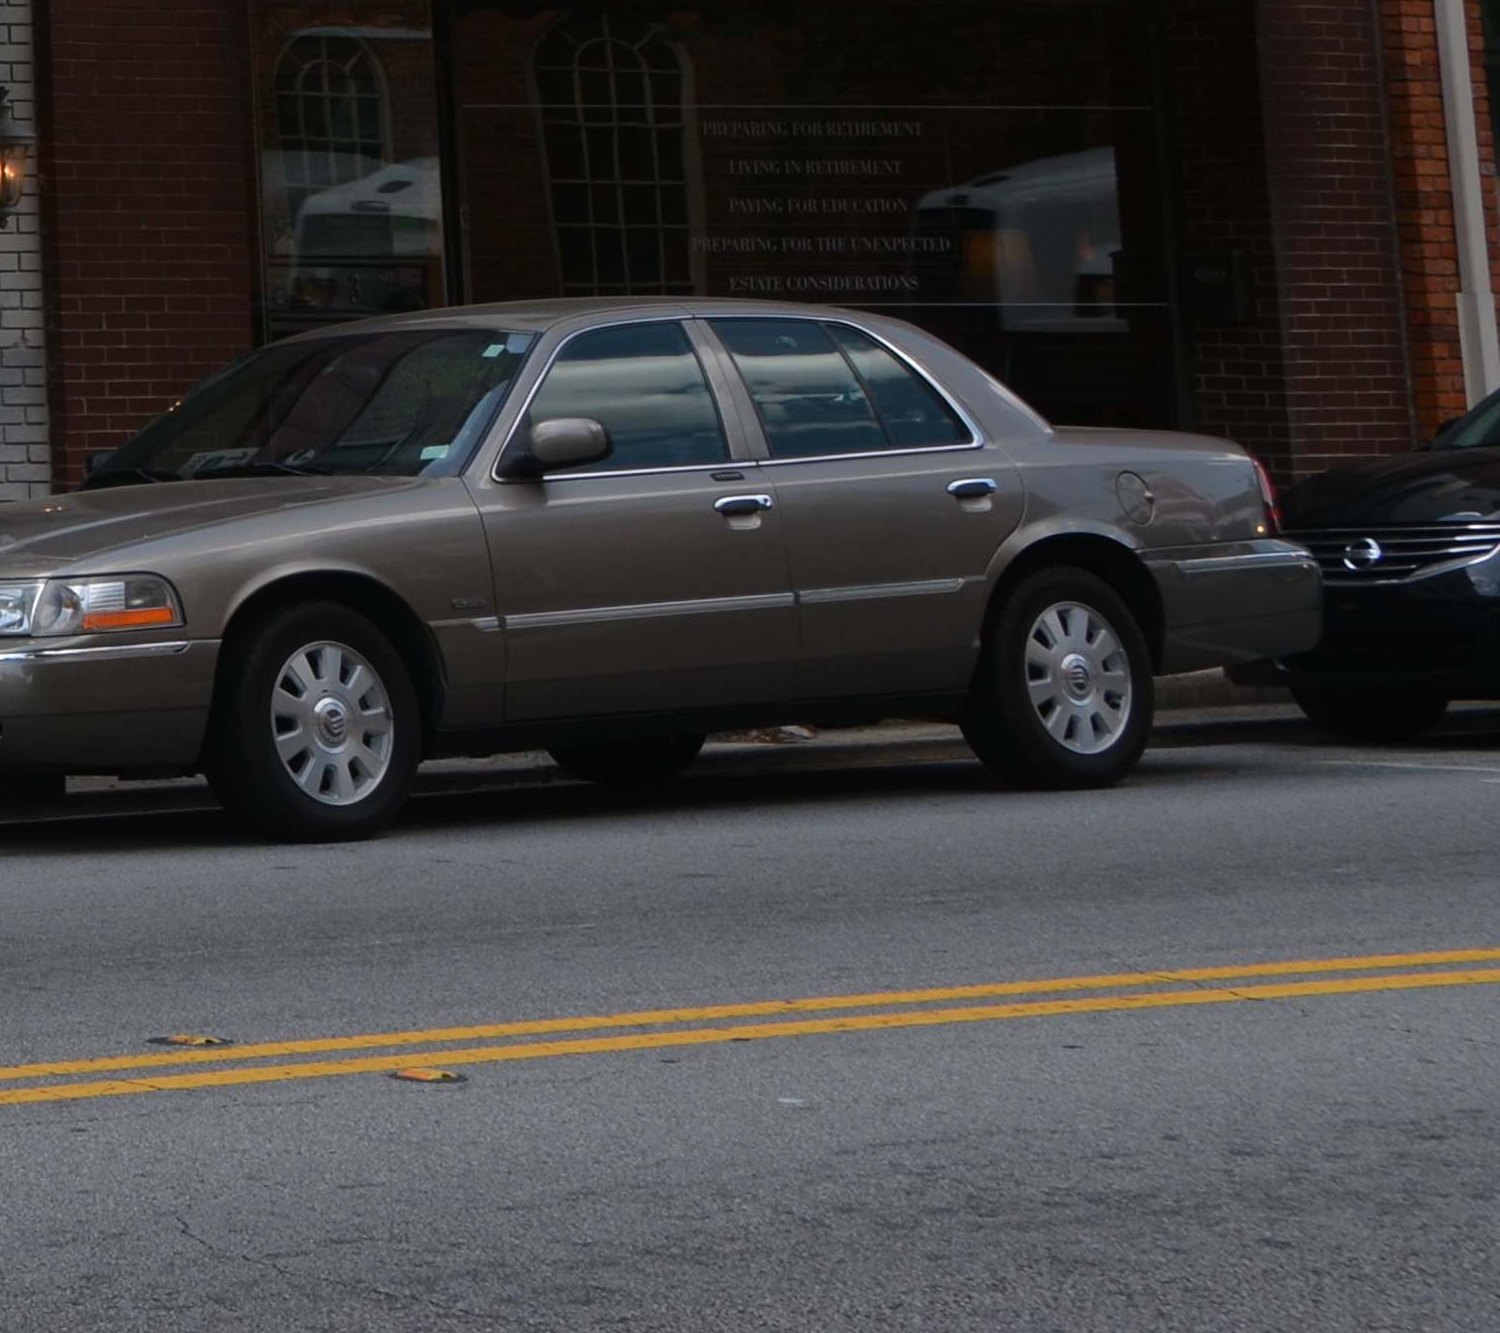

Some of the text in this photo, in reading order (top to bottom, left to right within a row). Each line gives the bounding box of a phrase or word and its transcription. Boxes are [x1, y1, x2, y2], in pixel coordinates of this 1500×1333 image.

[702, 121, 924, 137] PREPARING FOR RETIREMENT
[729, 160, 904, 175] LIVING IN RETIREMENT
[729, 198, 908, 214] PAYING FOR EDUCATION
[692, 237, 950, 252] PREPARING FOR THE UNEXPECTED
[730, 275, 919, 291] ESTATE CONSIDERATIONS
